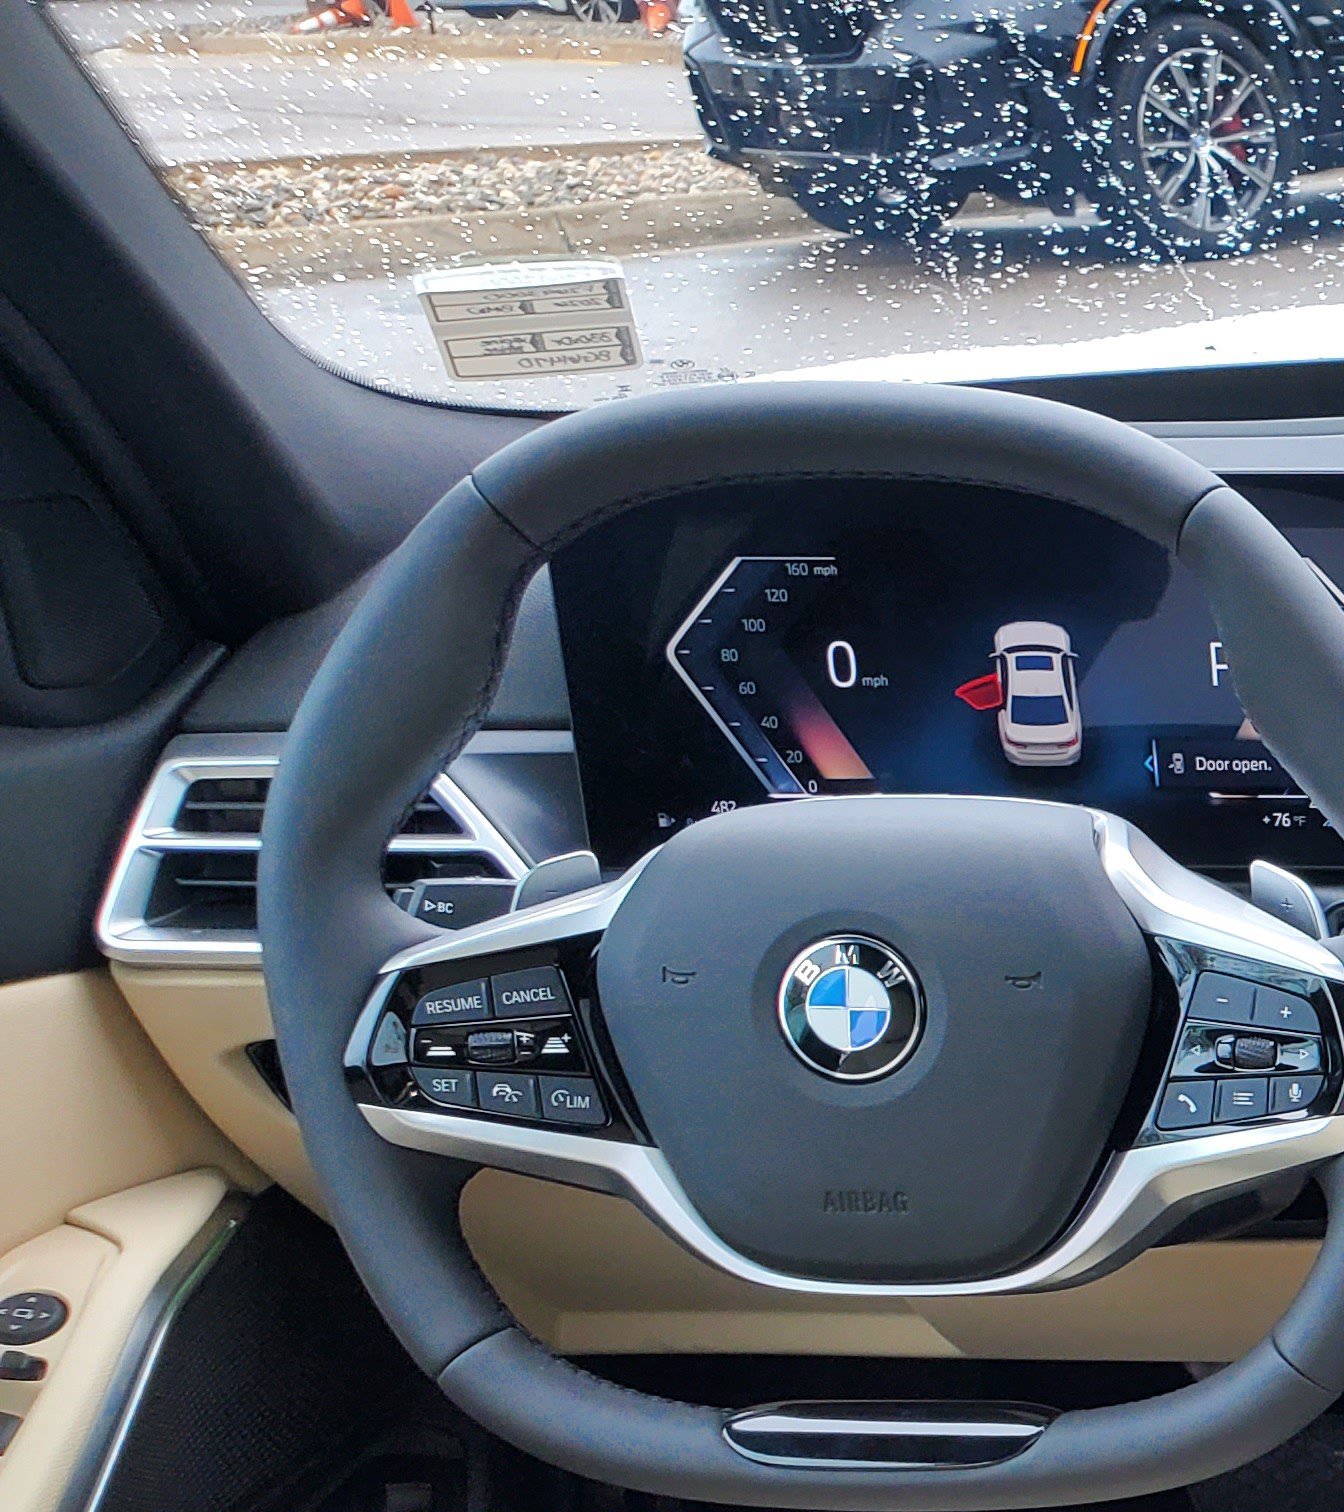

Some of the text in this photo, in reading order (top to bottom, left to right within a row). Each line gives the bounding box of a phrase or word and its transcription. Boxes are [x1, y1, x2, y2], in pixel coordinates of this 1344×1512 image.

[785, 562, 838, 577] 160 mph
[765, 588, 788, 602] 120
[741, 618, 766, 633] 100
[721, 648, 739, 662] 80
[827, 640, 889, 688] 0 mph
[739, 681, 756, 695] 60
[761, 715, 779, 729] 40
[786, 750, 803, 764] 20
[1195, 756, 1273, 774] Door open.
[808, 779, 818, 793] 0
[436, 902, 454, 914] BC
[794, 944, 906, 988] BMW
[502, 987, 556, 1005] CANCEL
[426, 996, 482, 1015] RESUME
[432, 1078, 458, 1092] SET
[566, 1096, 590, 1109] LIM
[823, 1190, 910, 1214] AIRBAG
